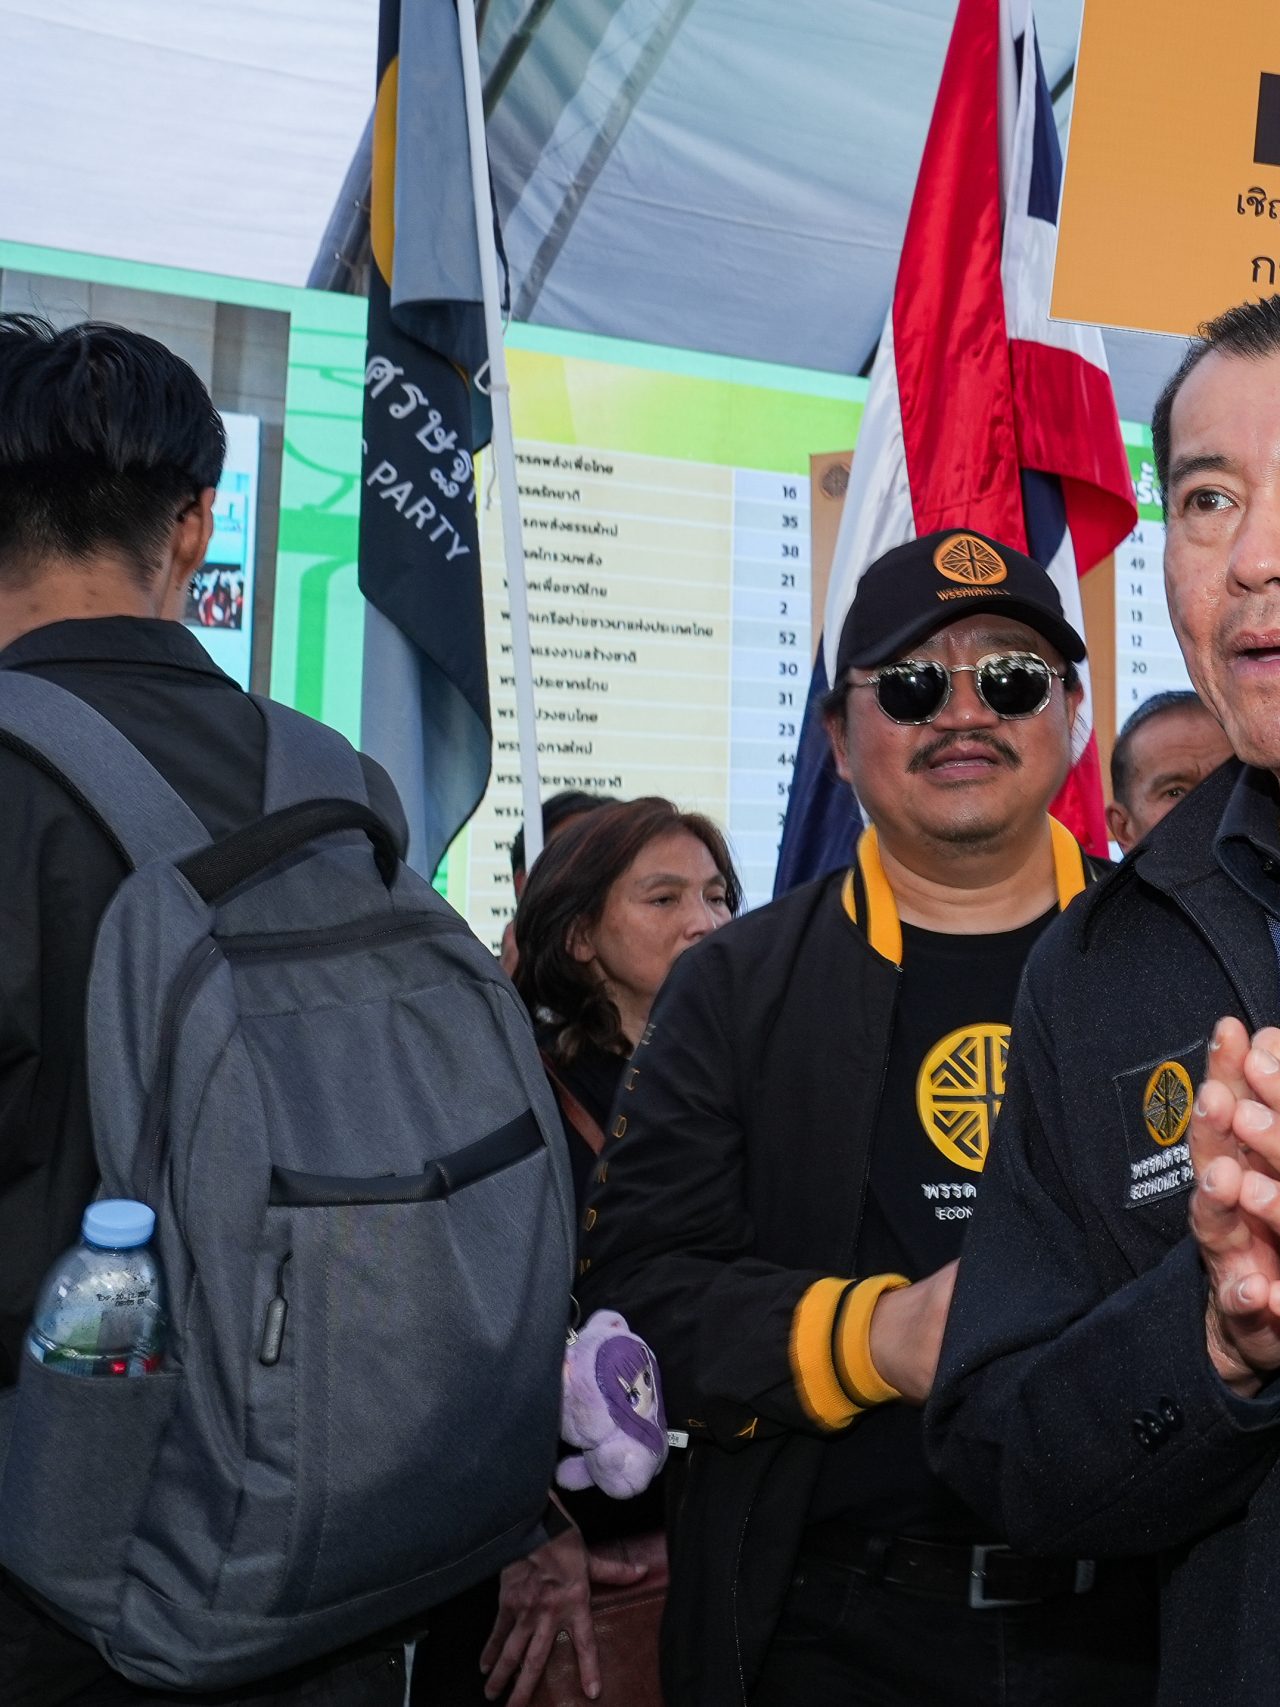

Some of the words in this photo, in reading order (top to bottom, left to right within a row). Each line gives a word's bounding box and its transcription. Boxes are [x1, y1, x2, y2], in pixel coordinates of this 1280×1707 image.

[515, 454, 614, 475] รรคพลังเพื่อไทย
[518, 484, 580, 502] รรครักชาติ
[782, 485, 797, 500] 16
[366, 460, 470, 561] PARTY
[782, 514, 798, 529] 35
[781, 573, 795, 587] 21
[1130, 583, 1143, 596] 14
[780, 602, 787, 615] 2
[779, 631, 796, 646] 52
[1131, 634, 1142, 647] 12
[779, 661, 798, 676] 30
[1132, 661, 1147, 674] 20
[778, 692, 793, 706] 31
[1132, 688, 1138, 700] 5
[778, 723, 795, 737] 23
[921, 1182, 977, 1200] พรรค
[1130, 1169, 1181, 1200] ECONOMIC
[935, 1206, 974, 1220] ECON
